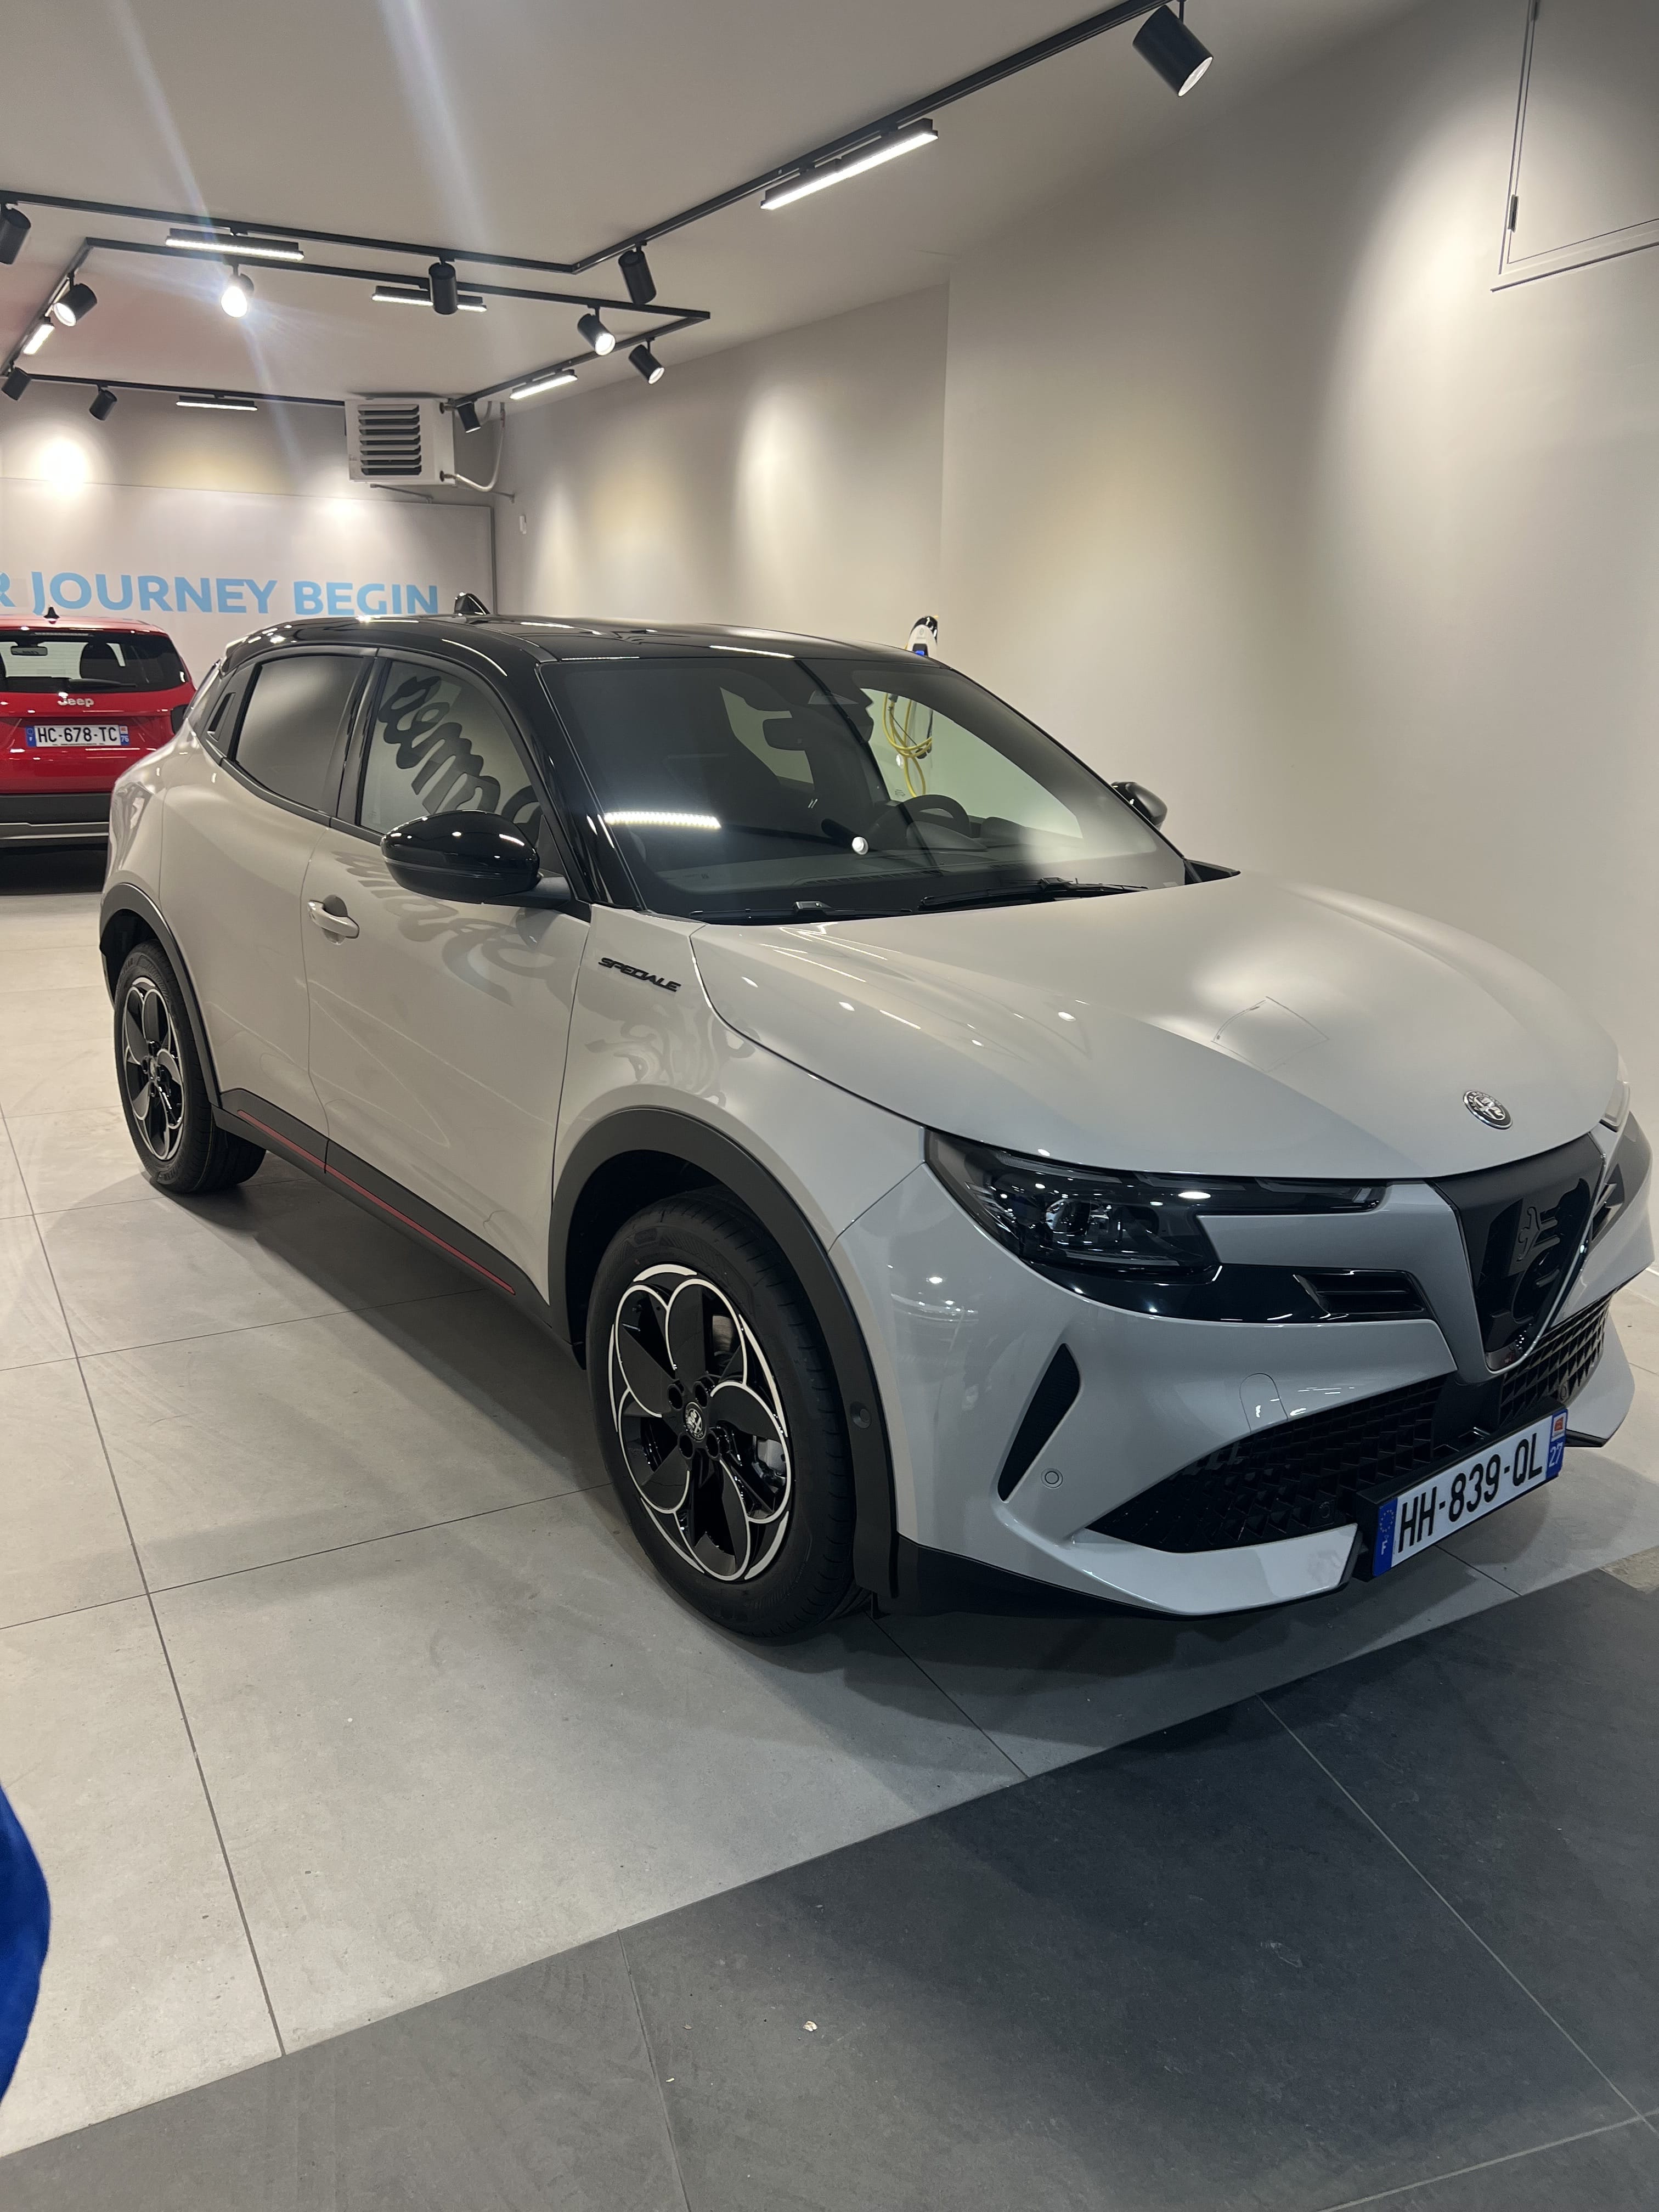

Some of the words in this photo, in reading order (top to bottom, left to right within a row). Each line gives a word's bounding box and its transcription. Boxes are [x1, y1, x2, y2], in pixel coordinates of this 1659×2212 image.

[31, 571, 278, 616] JOURNEY
[294, 580, 438, 616] BEGIN
[57, 692, 94, 707] Jeep
[38, 727, 117, 743] HC-678-TC
[1549, 1442, 1564, 1468] 27
[1398, 1432, 1543, 1554] HH-839-QL
[1381, 1540, 1388, 1555] F
